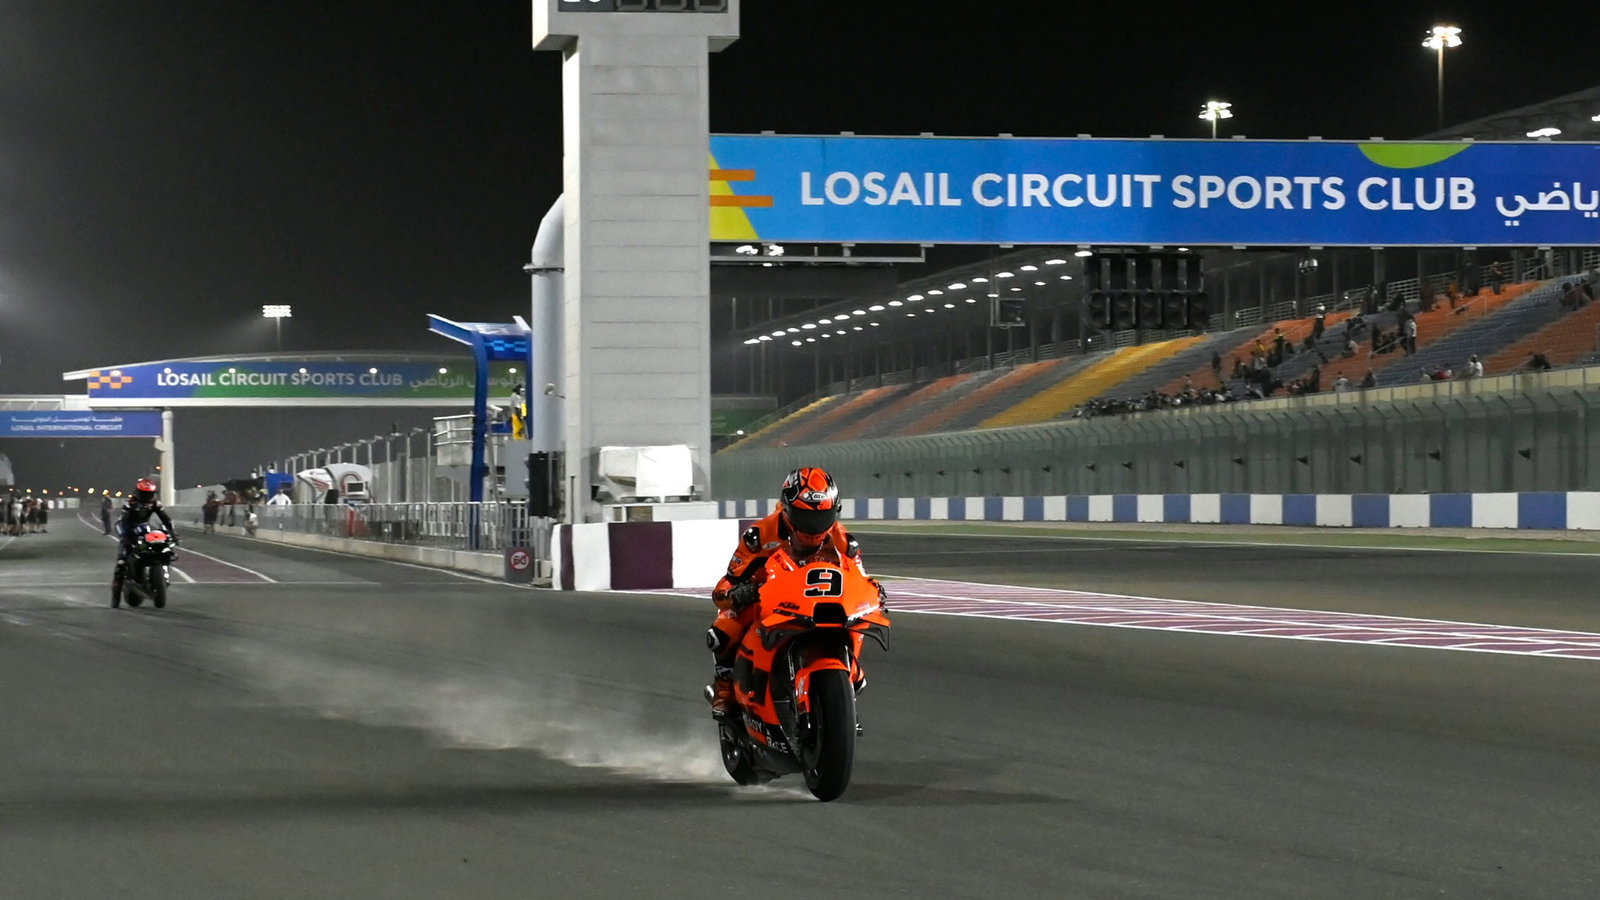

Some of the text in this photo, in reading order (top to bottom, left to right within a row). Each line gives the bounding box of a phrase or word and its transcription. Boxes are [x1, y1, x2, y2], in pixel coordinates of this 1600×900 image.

[801, 171, 1476, 211] LOSAIL CIRCUIT SPORTS CLUB
[157, 372, 403, 386] LOSAIL CIRCUIT SPORTS CLUB
[803, 568, 844, 598] 9
